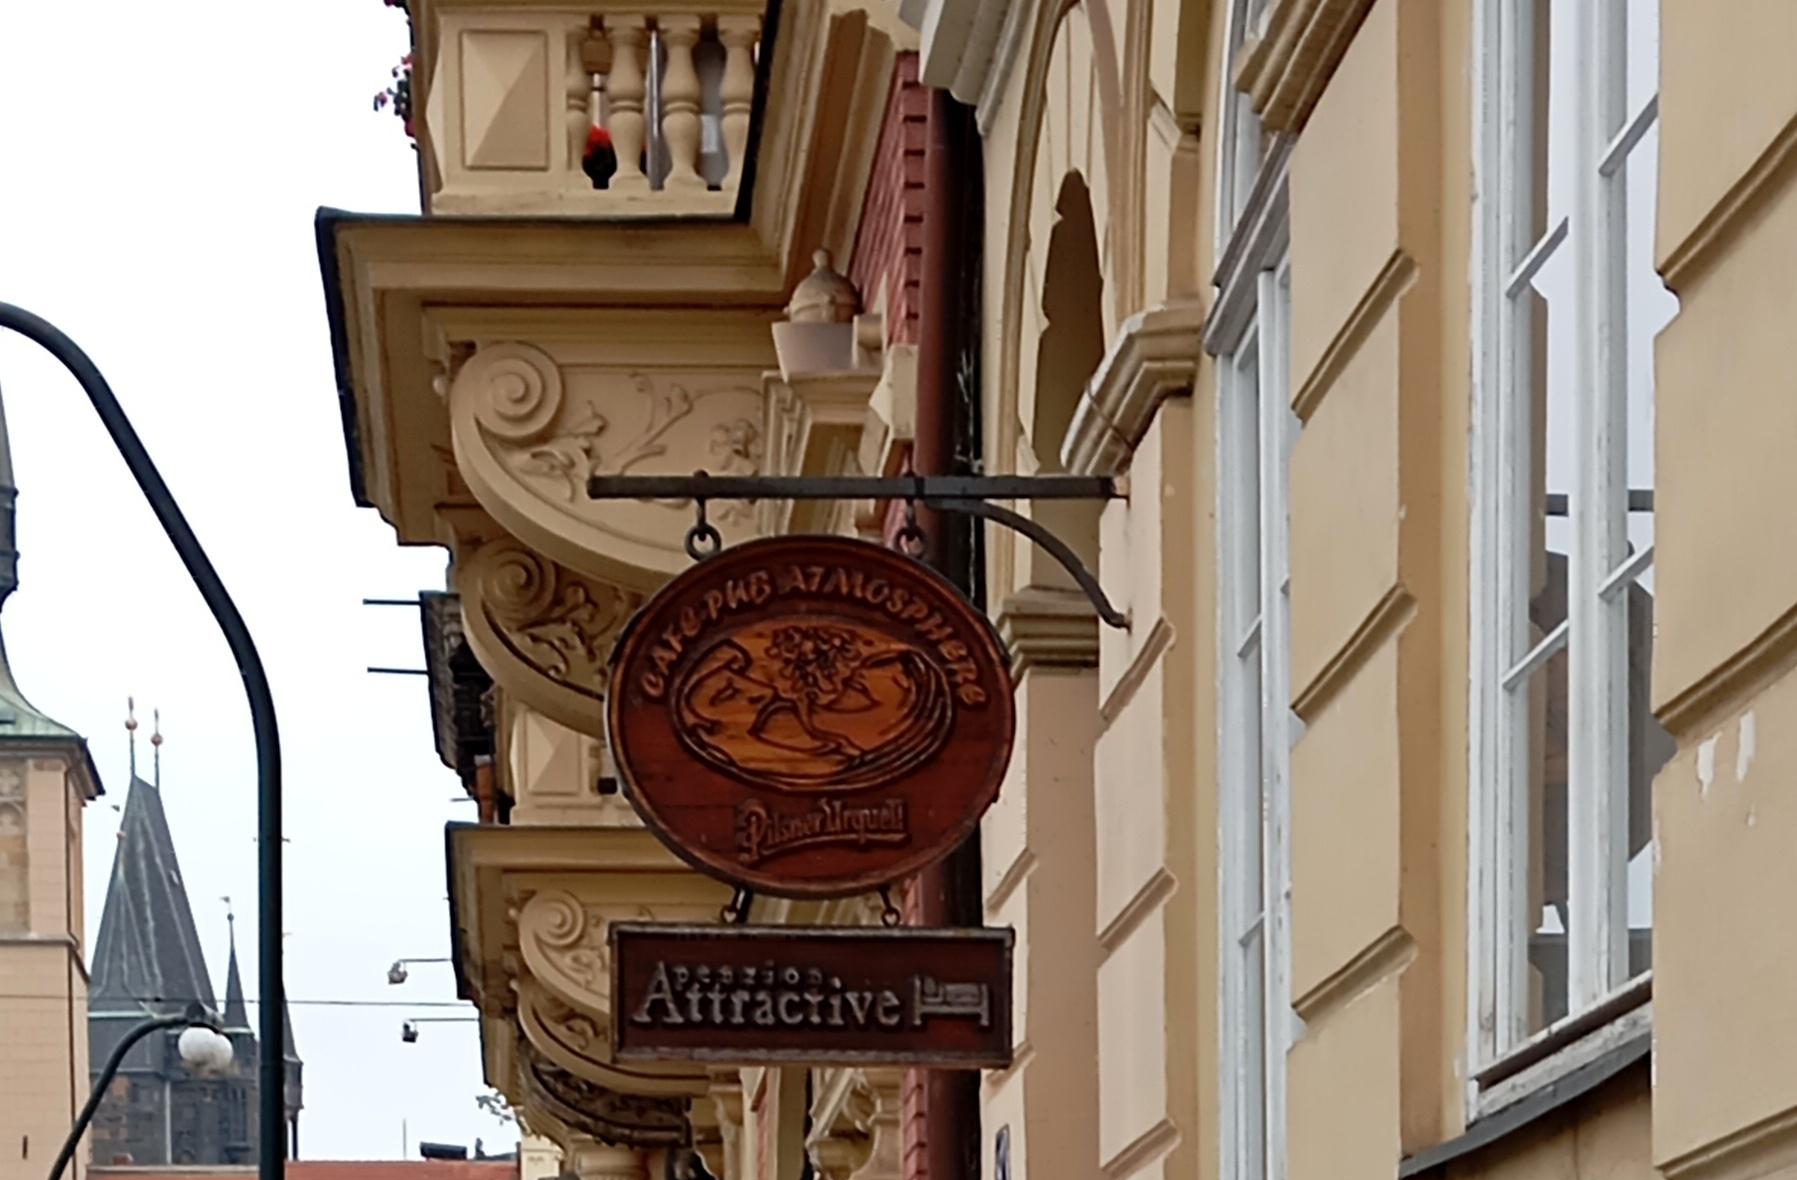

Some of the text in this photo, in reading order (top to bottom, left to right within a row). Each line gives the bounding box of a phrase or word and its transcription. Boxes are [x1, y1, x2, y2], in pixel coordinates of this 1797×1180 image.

[738, 798, 904, 861] Pilsner Urquell
[632, 961, 901, 1025] Attractive
